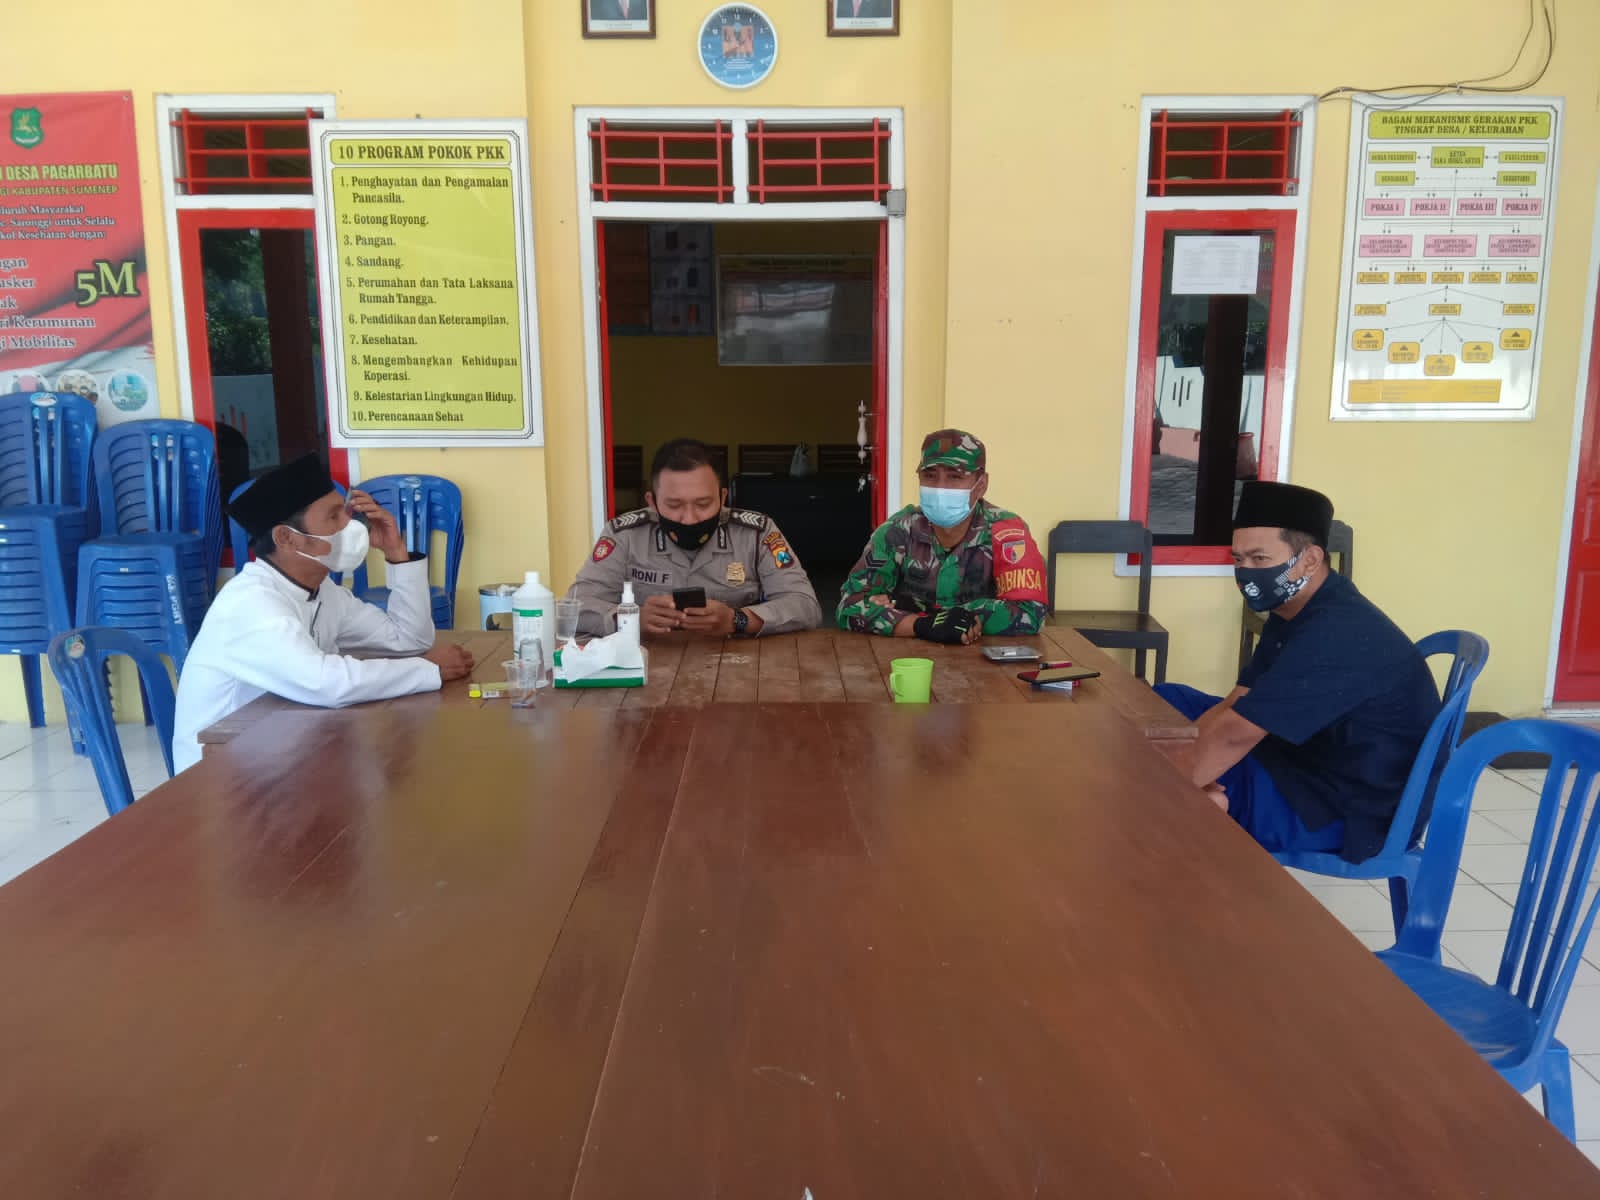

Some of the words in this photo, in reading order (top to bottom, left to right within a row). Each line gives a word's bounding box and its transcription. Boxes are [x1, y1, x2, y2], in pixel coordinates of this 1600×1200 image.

[1382, 116, 1413, 125] BAGAN
[1415, 115, 1471, 125] MEKANISME
[1473, 116, 1517, 125] GERAKAN
[1519, 116, 1539, 125] PKK
[1394, 126, 1435, 135] TINGKAT
[1436, 126, 1461, 135] DESA
[1469, 126, 1525, 135] KELURAHAN
[338, 146, 354, 159] 10
[358, 145, 424, 159] PROGRAM
[428, 145, 472, 159] POKOK
[476, 145, 505, 159] PKK
[6, 165, 39, 180] DESA
[42, 164, 118, 179] PAGARBATU
[340, 176, 349, 187] 1.
[351, 176, 418, 189] Penghayatan
[421, 176, 441, 187] dan
[445, 176, 509, 190] Pengamalan
[13, 187, 69, 196] KABUPATEN
[71, 185, 118, 194] SUMENEP
[352, 192, 405, 204] Pancasila.
[30, 205, 84, 215] Masyarakat
[54, 217, 82, 226] untuk
[84, 216, 115, 226] Selalu
[342, 214, 351, 225] 2.
[353, 214, 389, 227] Gotong
[390, 214, 429, 227] Royong.
[18, 231, 66, 239] Kesehatan
[343, 235, 353, 246] 3.
[355, 235, 396, 248] Pangan.
[345, 256, 354, 267] 4.
[356, 256, 404, 269] Sandang.
[76, 261, 139, 305] 5M
[346, 277, 355, 288] 5.
[358, 277, 416, 289] Perumahan
[420, 277, 439, 289] dan
[442, 277, 465, 289] Tata
[469, 277, 514, 289] Laksana
[359, 293, 395, 304] Rumah
[396, 293, 437, 306] Tangga.
[12, 314, 96, 328] Kerumunan
[348, 314, 358, 325] 6.
[360, 314, 416, 325] Pendidikan
[418, 314, 437, 325] dan
[439, 314, 509, 327] Keterampilan.
[10, 335, 76, 348] Mobilitas
[349, 335, 359, 345] 7.
[361, 334, 418, 345] Kesehatan.
[351, 355, 360, 366] 8.
[363, 355, 453, 368] Mengembangkan
[461, 355, 517, 368] Kehidupan
[364, 371, 411, 383] Koperasi.
[353, 391, 362, 401] 9.
[365, 391, 422, 402] Kelestarian
[424, 391, 483, 403] Lingkungan
[485, 391, 516, 404] Hidup.
[352, 411, 367, 422] 10.
[368, 411, 434, 422] Perencanaan
[435, 411, 464, 422] Sehat
[632, 568, 657, 582] RONI
[662, 573, 669, 583] F
